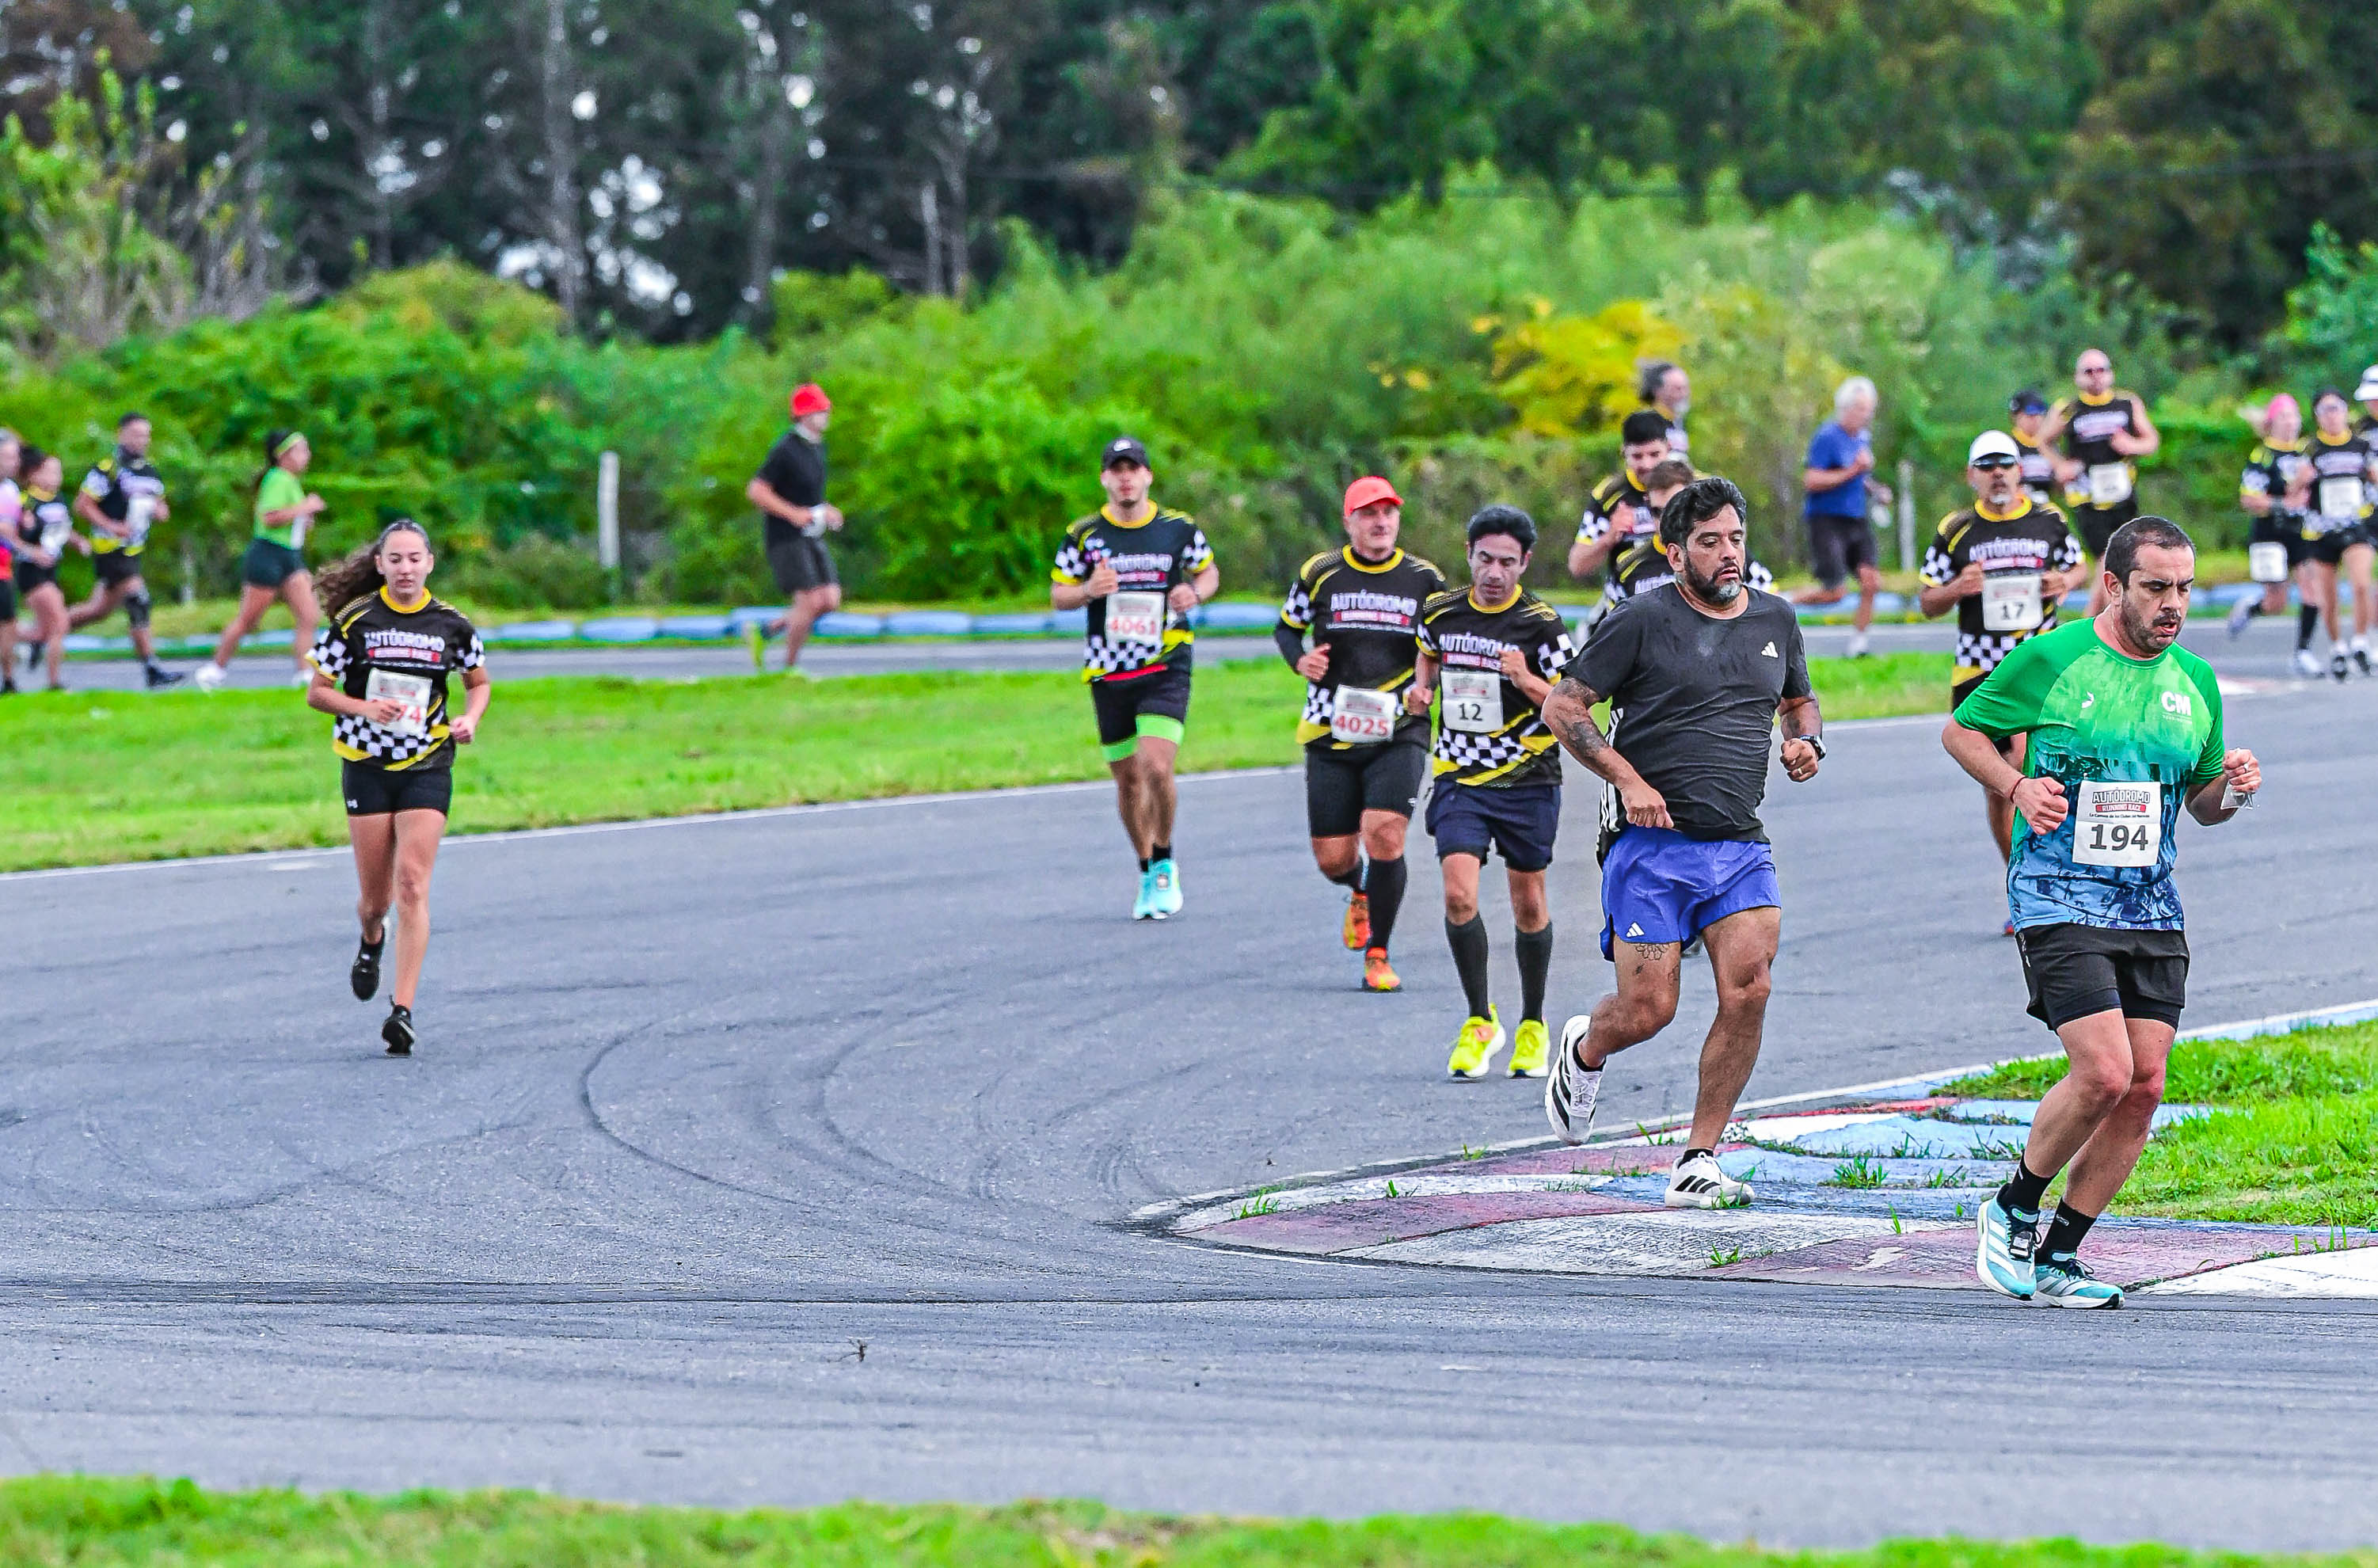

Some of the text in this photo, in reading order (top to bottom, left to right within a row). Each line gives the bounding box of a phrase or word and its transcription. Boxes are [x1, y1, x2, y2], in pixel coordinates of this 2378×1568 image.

[2001, 603, 2025, 619] 17
[1459, 703, 1483, 721] 12
[2161, 691, 2192, 717] CM
[1334, 715, 1388, 736] 4025
[2092, 787, 2150, 804] AUTÓDROMO
[2090, 824, 2148, 851] 194
